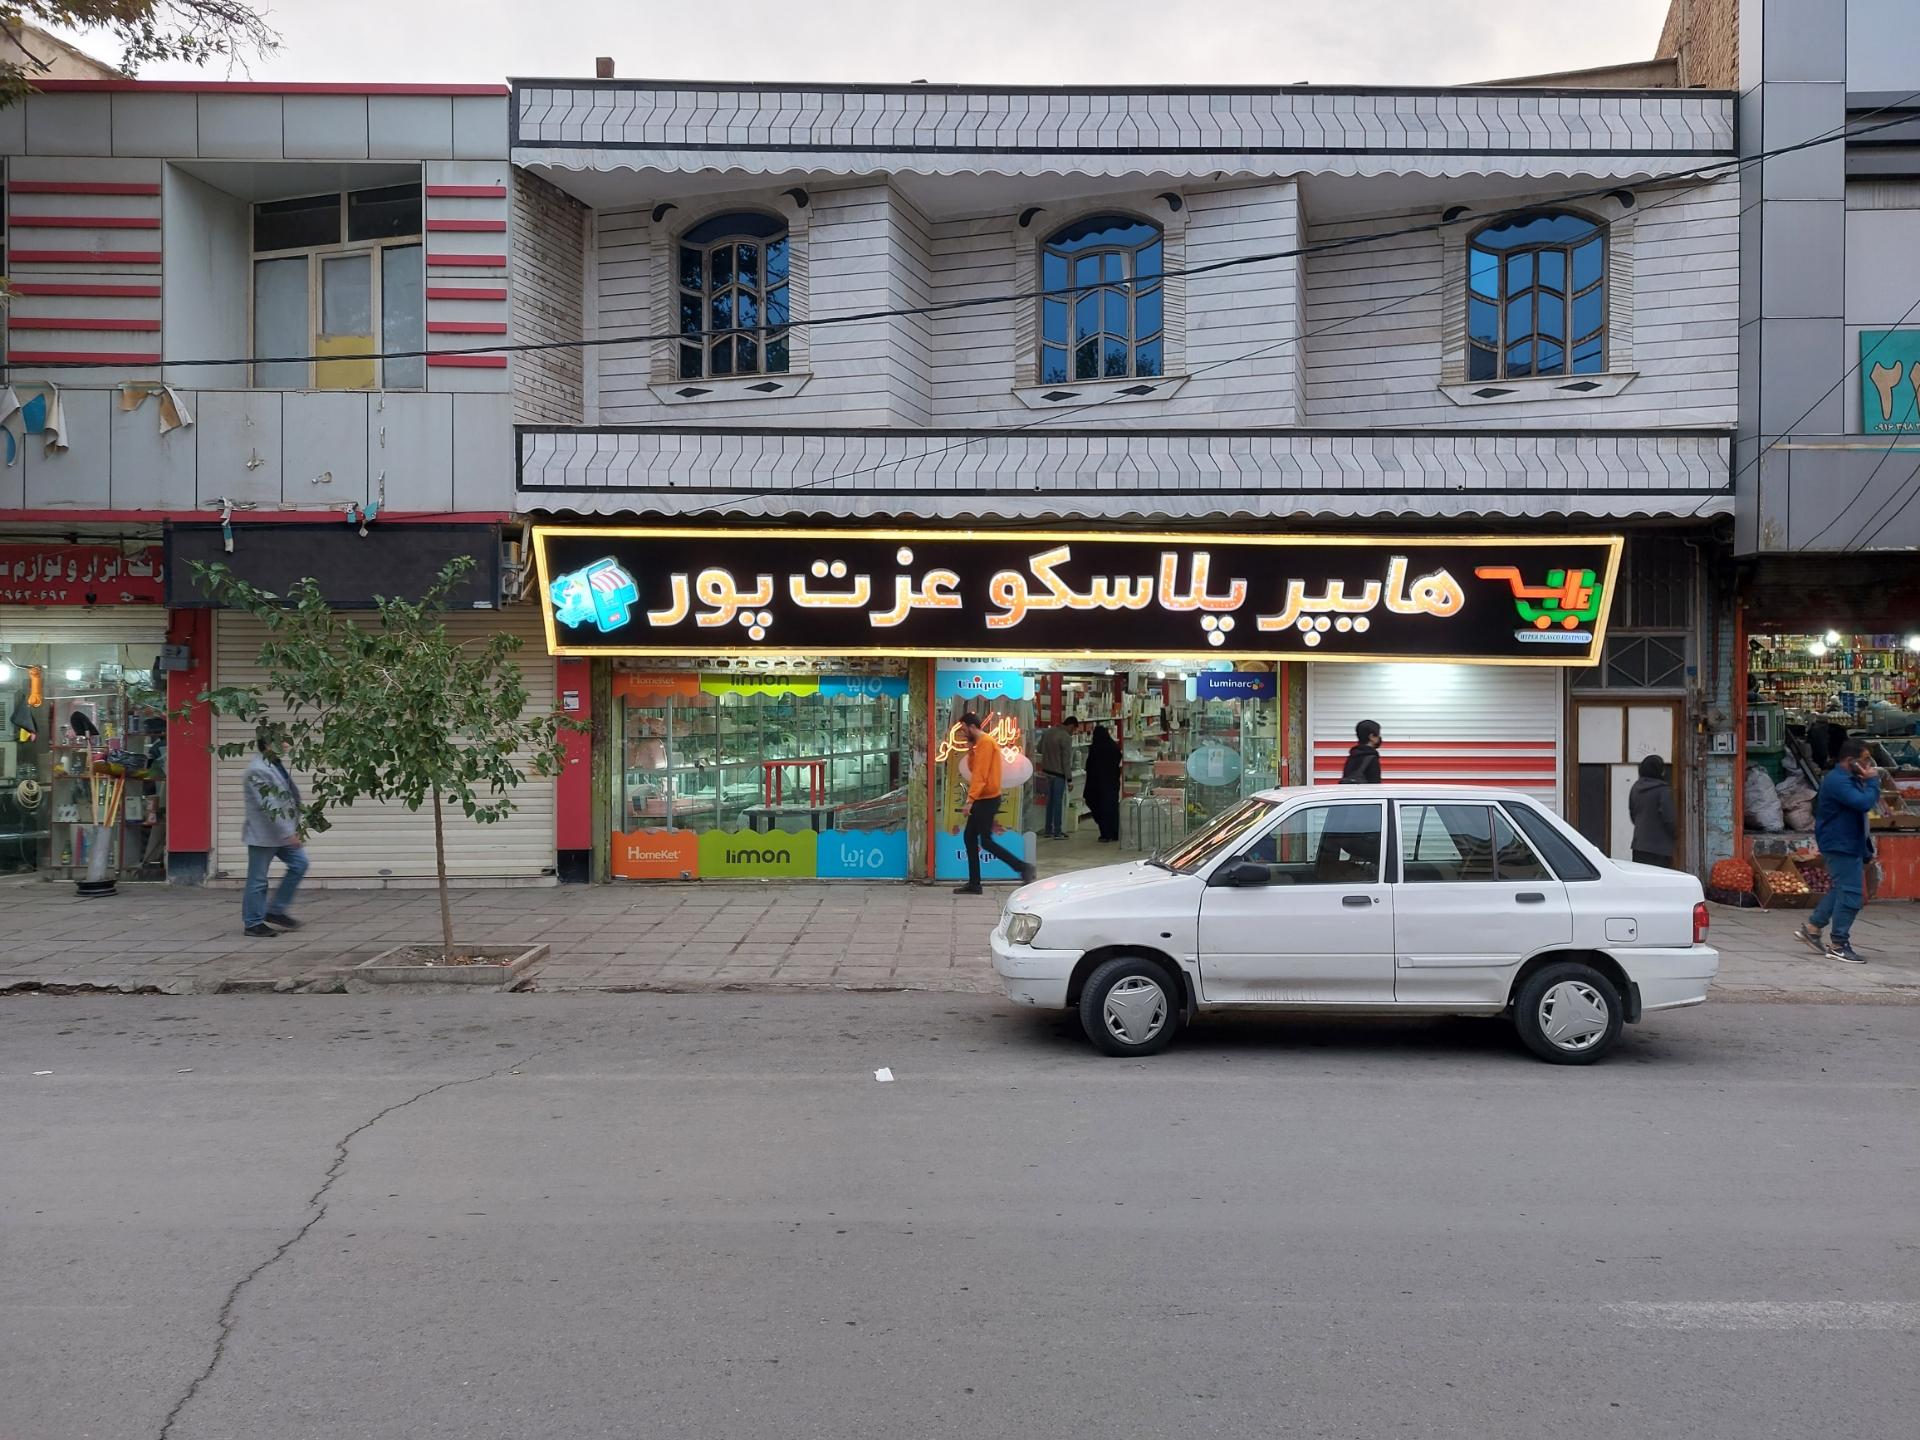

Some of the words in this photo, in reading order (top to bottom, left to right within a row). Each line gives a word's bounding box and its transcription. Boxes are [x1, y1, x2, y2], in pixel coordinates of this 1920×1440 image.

[647, 567, 774, 641] پور
[789, 546, 963, 627] عزت
[985, 544, 1247, 646] پلاسکو
[1256, 555, 1465, 646] هایپر
[958, 676, 1004, 690] Unique
[1209, 679, 1252, 688] Luminarc
[726, 849, 790, 864] limon
